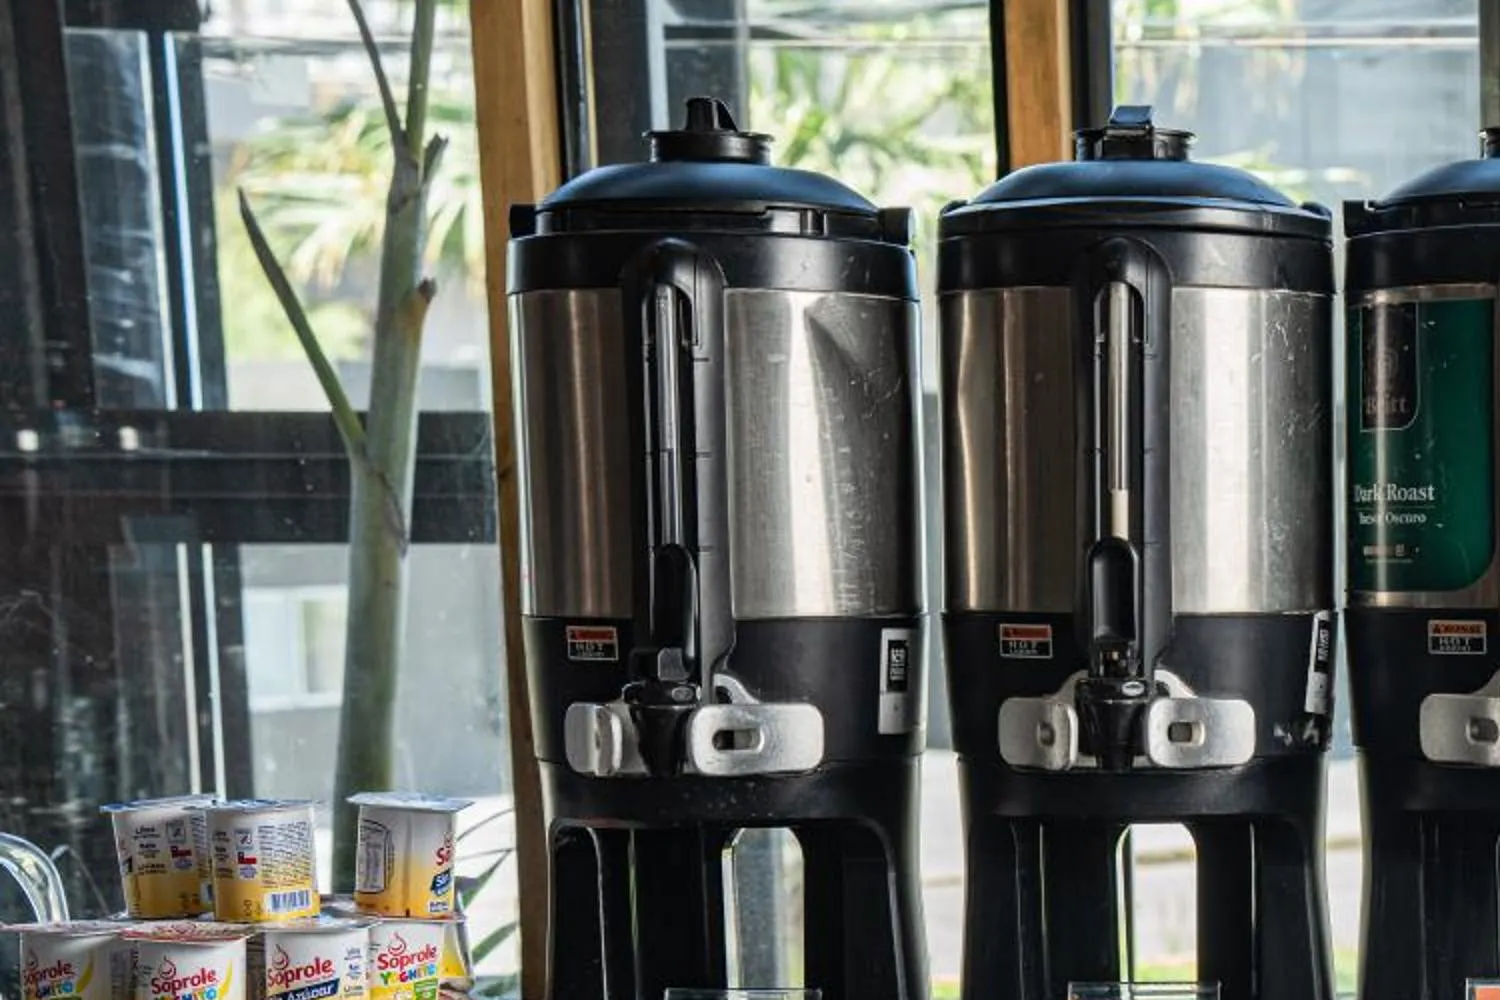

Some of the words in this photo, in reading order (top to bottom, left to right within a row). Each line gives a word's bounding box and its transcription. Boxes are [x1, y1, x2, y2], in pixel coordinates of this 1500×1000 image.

[1387, 483, 1435, 501] Roast
[1385, 511, 1427, 526] Oscuro
[378, 943, 437, 971] Soprole
[151, 967, 217, 996] Soprole
[266, 955, 334, 989] Soprole
